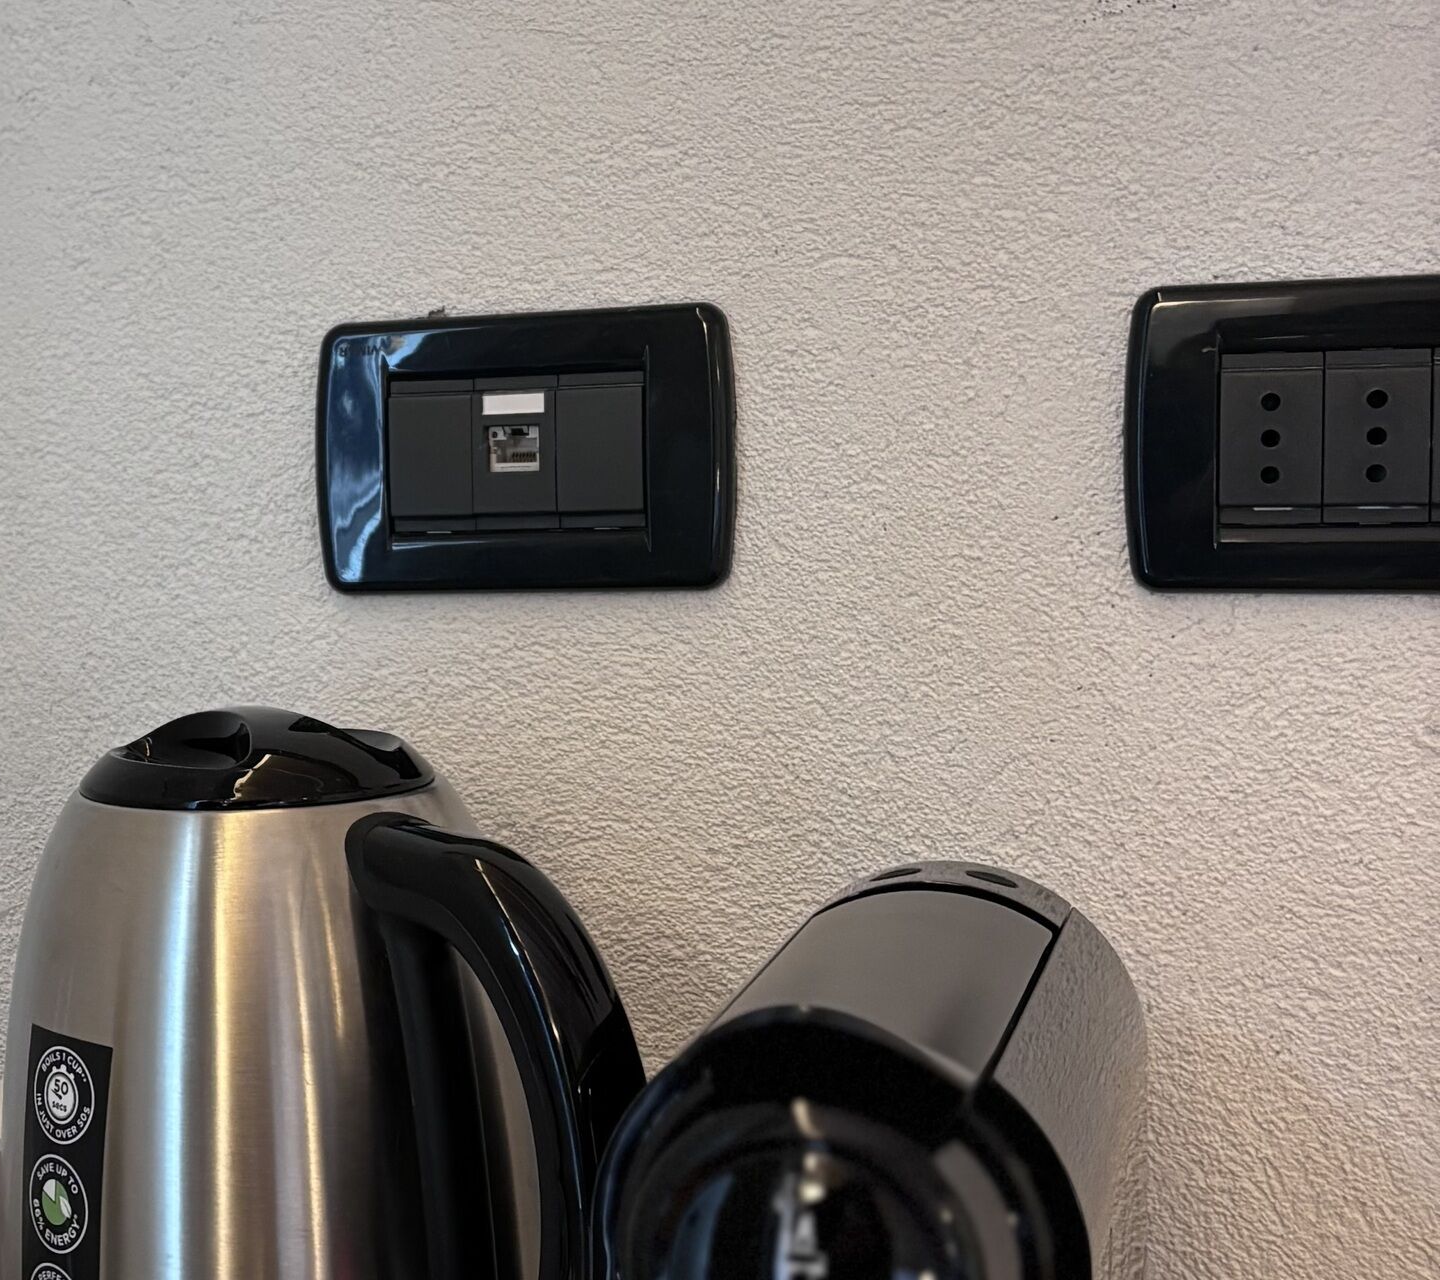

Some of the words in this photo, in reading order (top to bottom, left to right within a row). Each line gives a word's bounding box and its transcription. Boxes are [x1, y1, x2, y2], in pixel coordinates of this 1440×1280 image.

[41, 1051, 61, 1072] BOILS
[54, 1079, 69, 1095] 50
[36, 1093, 42, 1105] IN
[40, 1110, 54, 1134] JUST
[56, 1126, 78, 1138] OVER
[52, 1101, 67, 1112] secs
[37, 1162, 55, 1180] SAVE
[56, 1164, 68, 1177] UP
[68, 1176, 78, 1194] TO
